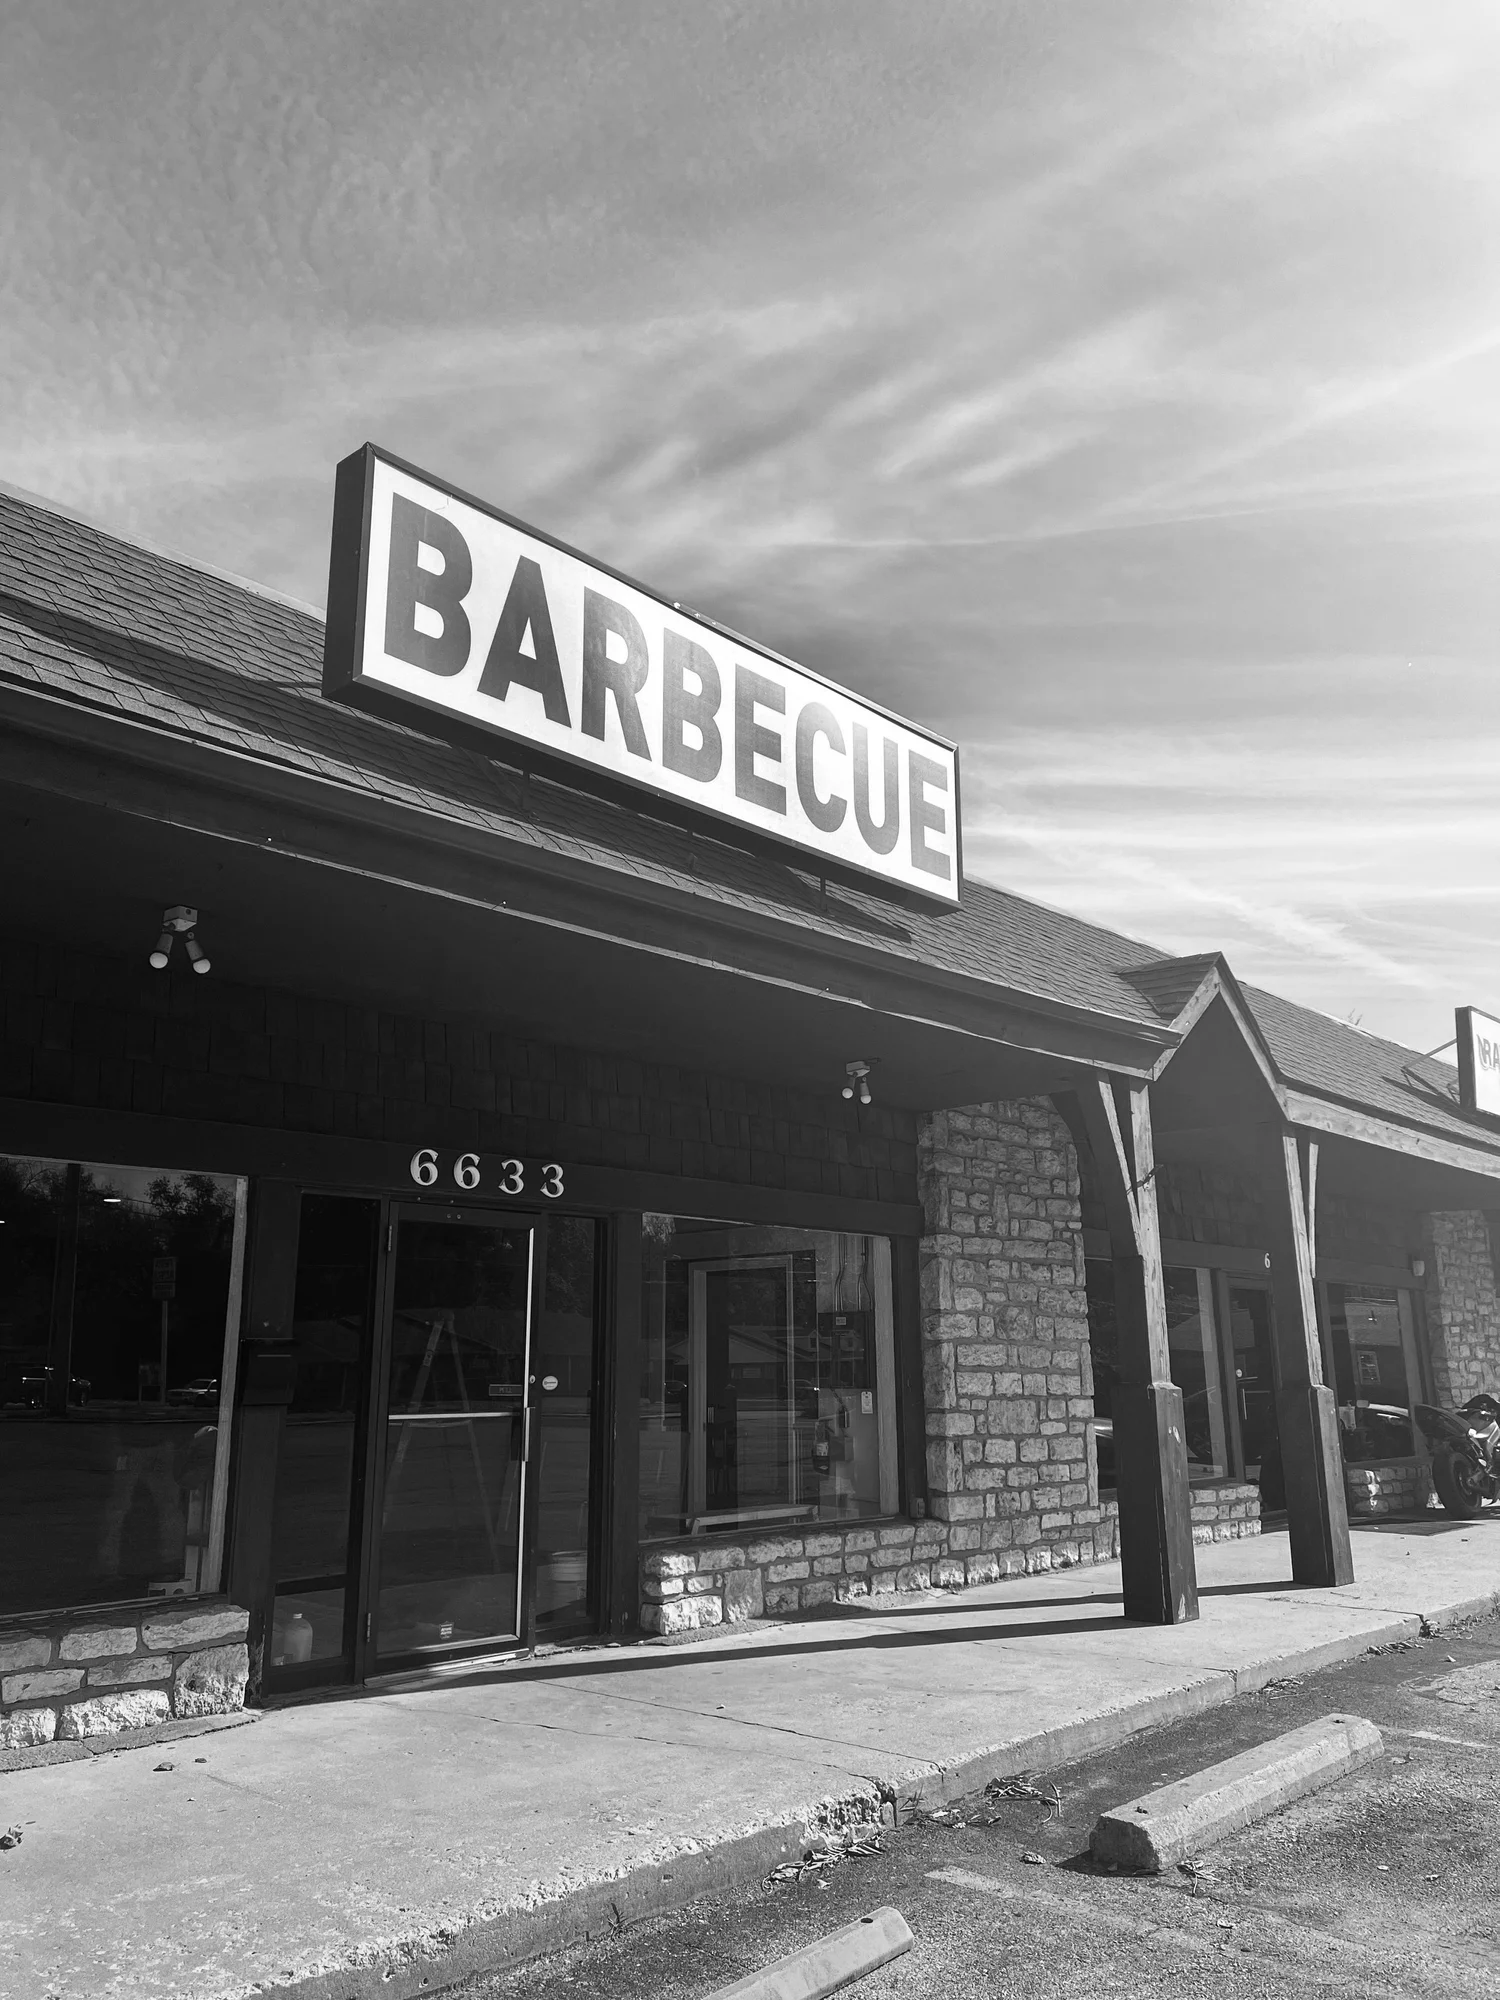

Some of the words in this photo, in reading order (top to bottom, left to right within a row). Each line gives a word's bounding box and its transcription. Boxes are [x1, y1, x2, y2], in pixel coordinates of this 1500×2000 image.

[384, 491, 951, 881] BARBECUE
[410, 1149, 564, 1198] 6633
[1264, 1252, 1271, 1269] 6
